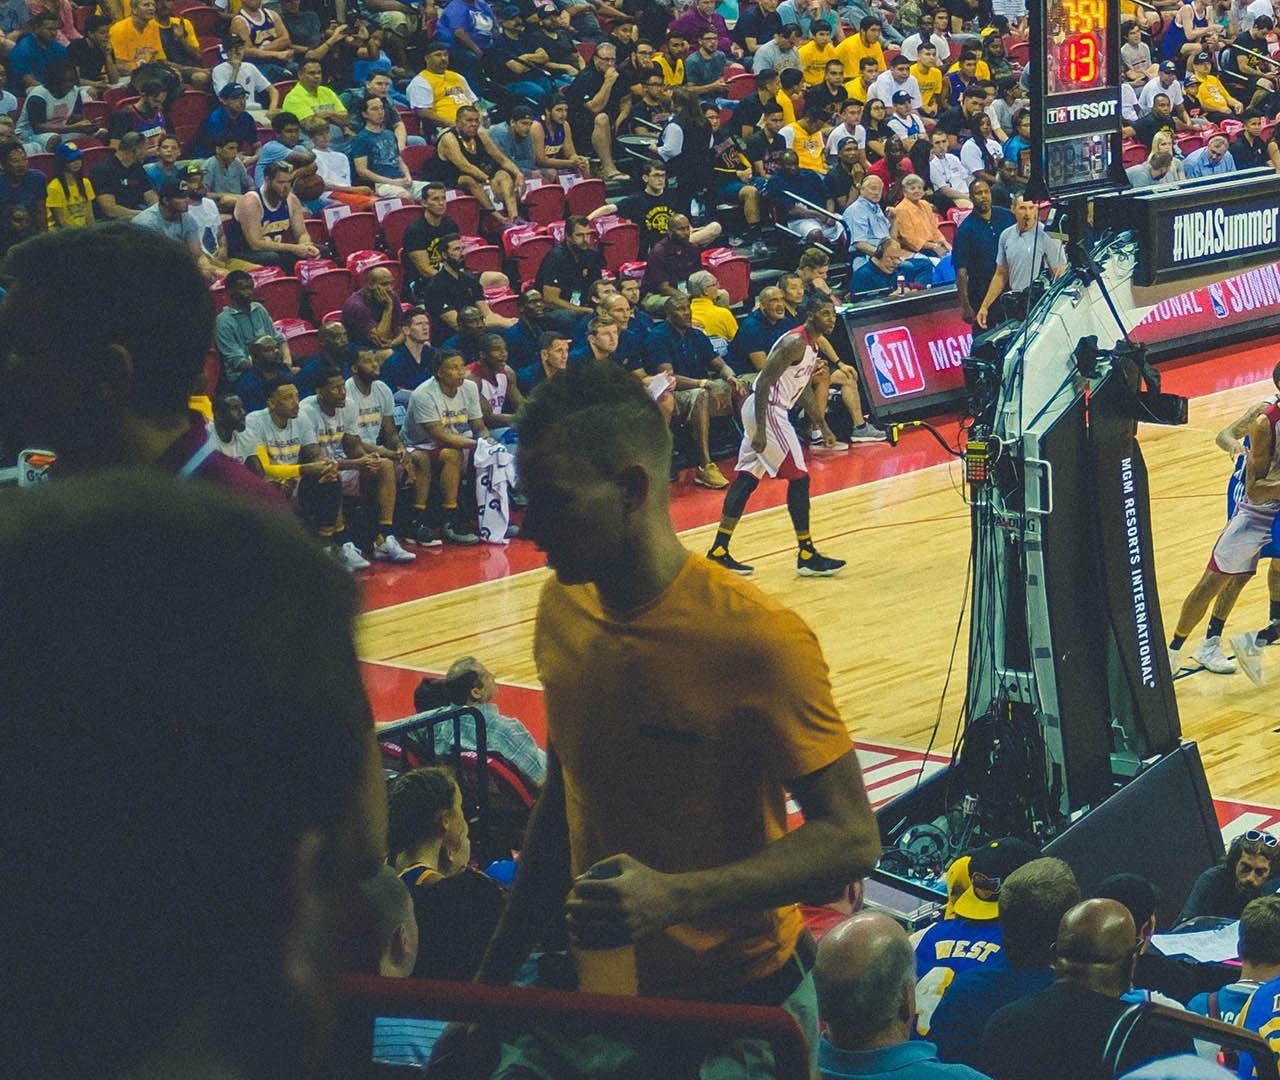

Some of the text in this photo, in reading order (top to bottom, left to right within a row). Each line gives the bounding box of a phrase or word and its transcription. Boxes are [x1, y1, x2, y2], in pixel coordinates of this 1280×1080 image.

[1068, 34, 1097, 83] 13
[1068, 99, 1118, 121] TISSOT
[1172, 207, 1279, 263] #NBASummer
[887, 340, 915, 381] TV
[1120, 457, 1154, 686] MGM RESORTS INTERNATIONAL
[934, 939, 1001, 963] WEST
